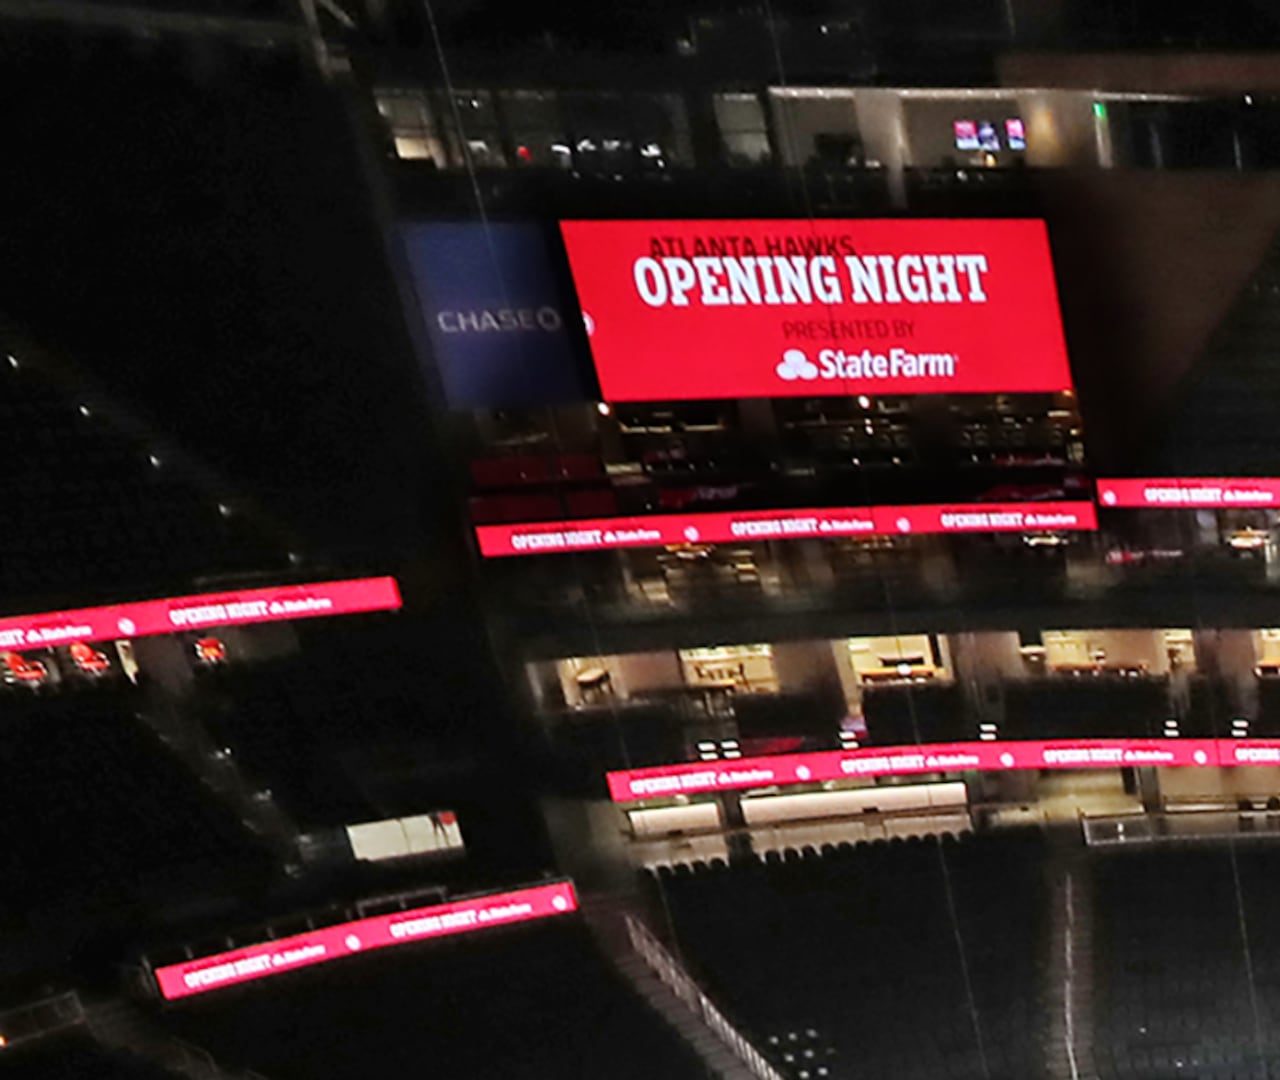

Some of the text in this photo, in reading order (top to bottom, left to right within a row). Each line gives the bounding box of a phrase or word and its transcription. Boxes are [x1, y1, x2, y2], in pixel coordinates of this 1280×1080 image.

[633, 254, 988, 307] OPENING NIGHT
[438, 308, 538, 334] CHASE
[783, 320, 916, 342] PRESENTED BY
